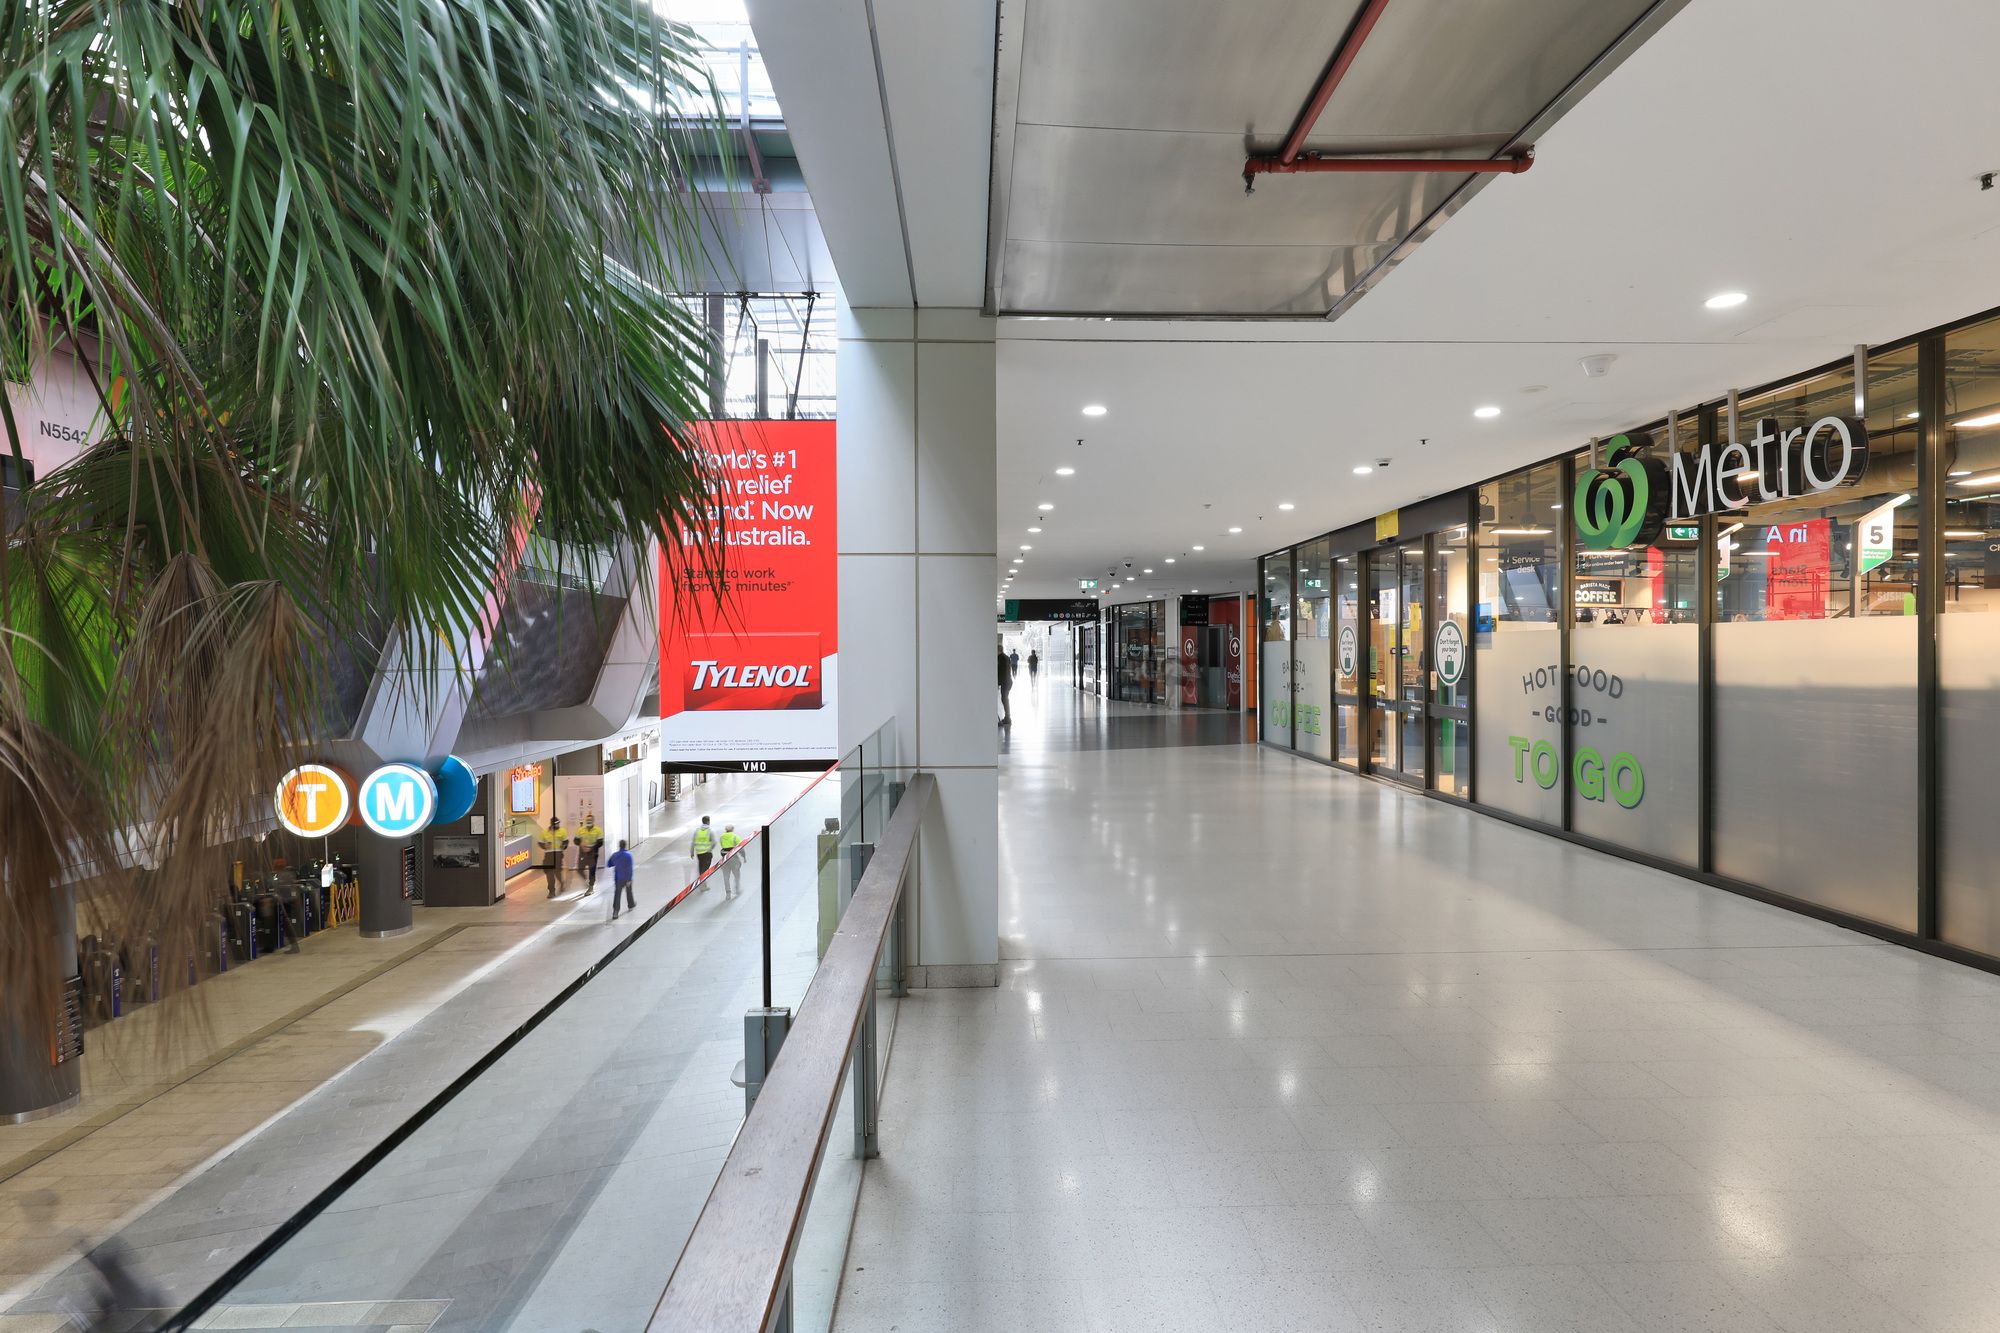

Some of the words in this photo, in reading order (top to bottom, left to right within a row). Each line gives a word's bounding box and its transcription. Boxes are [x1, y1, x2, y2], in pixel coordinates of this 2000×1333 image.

[773, 450, 796, 469] #1
[1671, 416, 1853, 519] Metro
[737, 474, 792, 494] relief
[762, 502, 813, 520] Now
[683, 526, 702, 546] in
[709, 526, 811, 546] Australia.
[1870, 526, 1884, 544] 5
[1512, 556, 1540, 564] Service
[1517, 565, 1535, 573] desk
[726, 569, 739, 578] to
[744, 568, 775, 578] work
[1575, 590, 1616, 603] COFFEE
[1282, 659, 1306, 675] BASTA
[1522, 664, 1557, 695] HOT
[1271, 700, 1321, 735] COFEE
[742, 761, 767, 772] VMO
[1508, 735, 1559, 789] TO
[1572, 745, 1644, 809] GO
[297, 783, 327, 823] T
[376, 781, 415, 822] M
[505, 850, 529, 869] Sharetea
